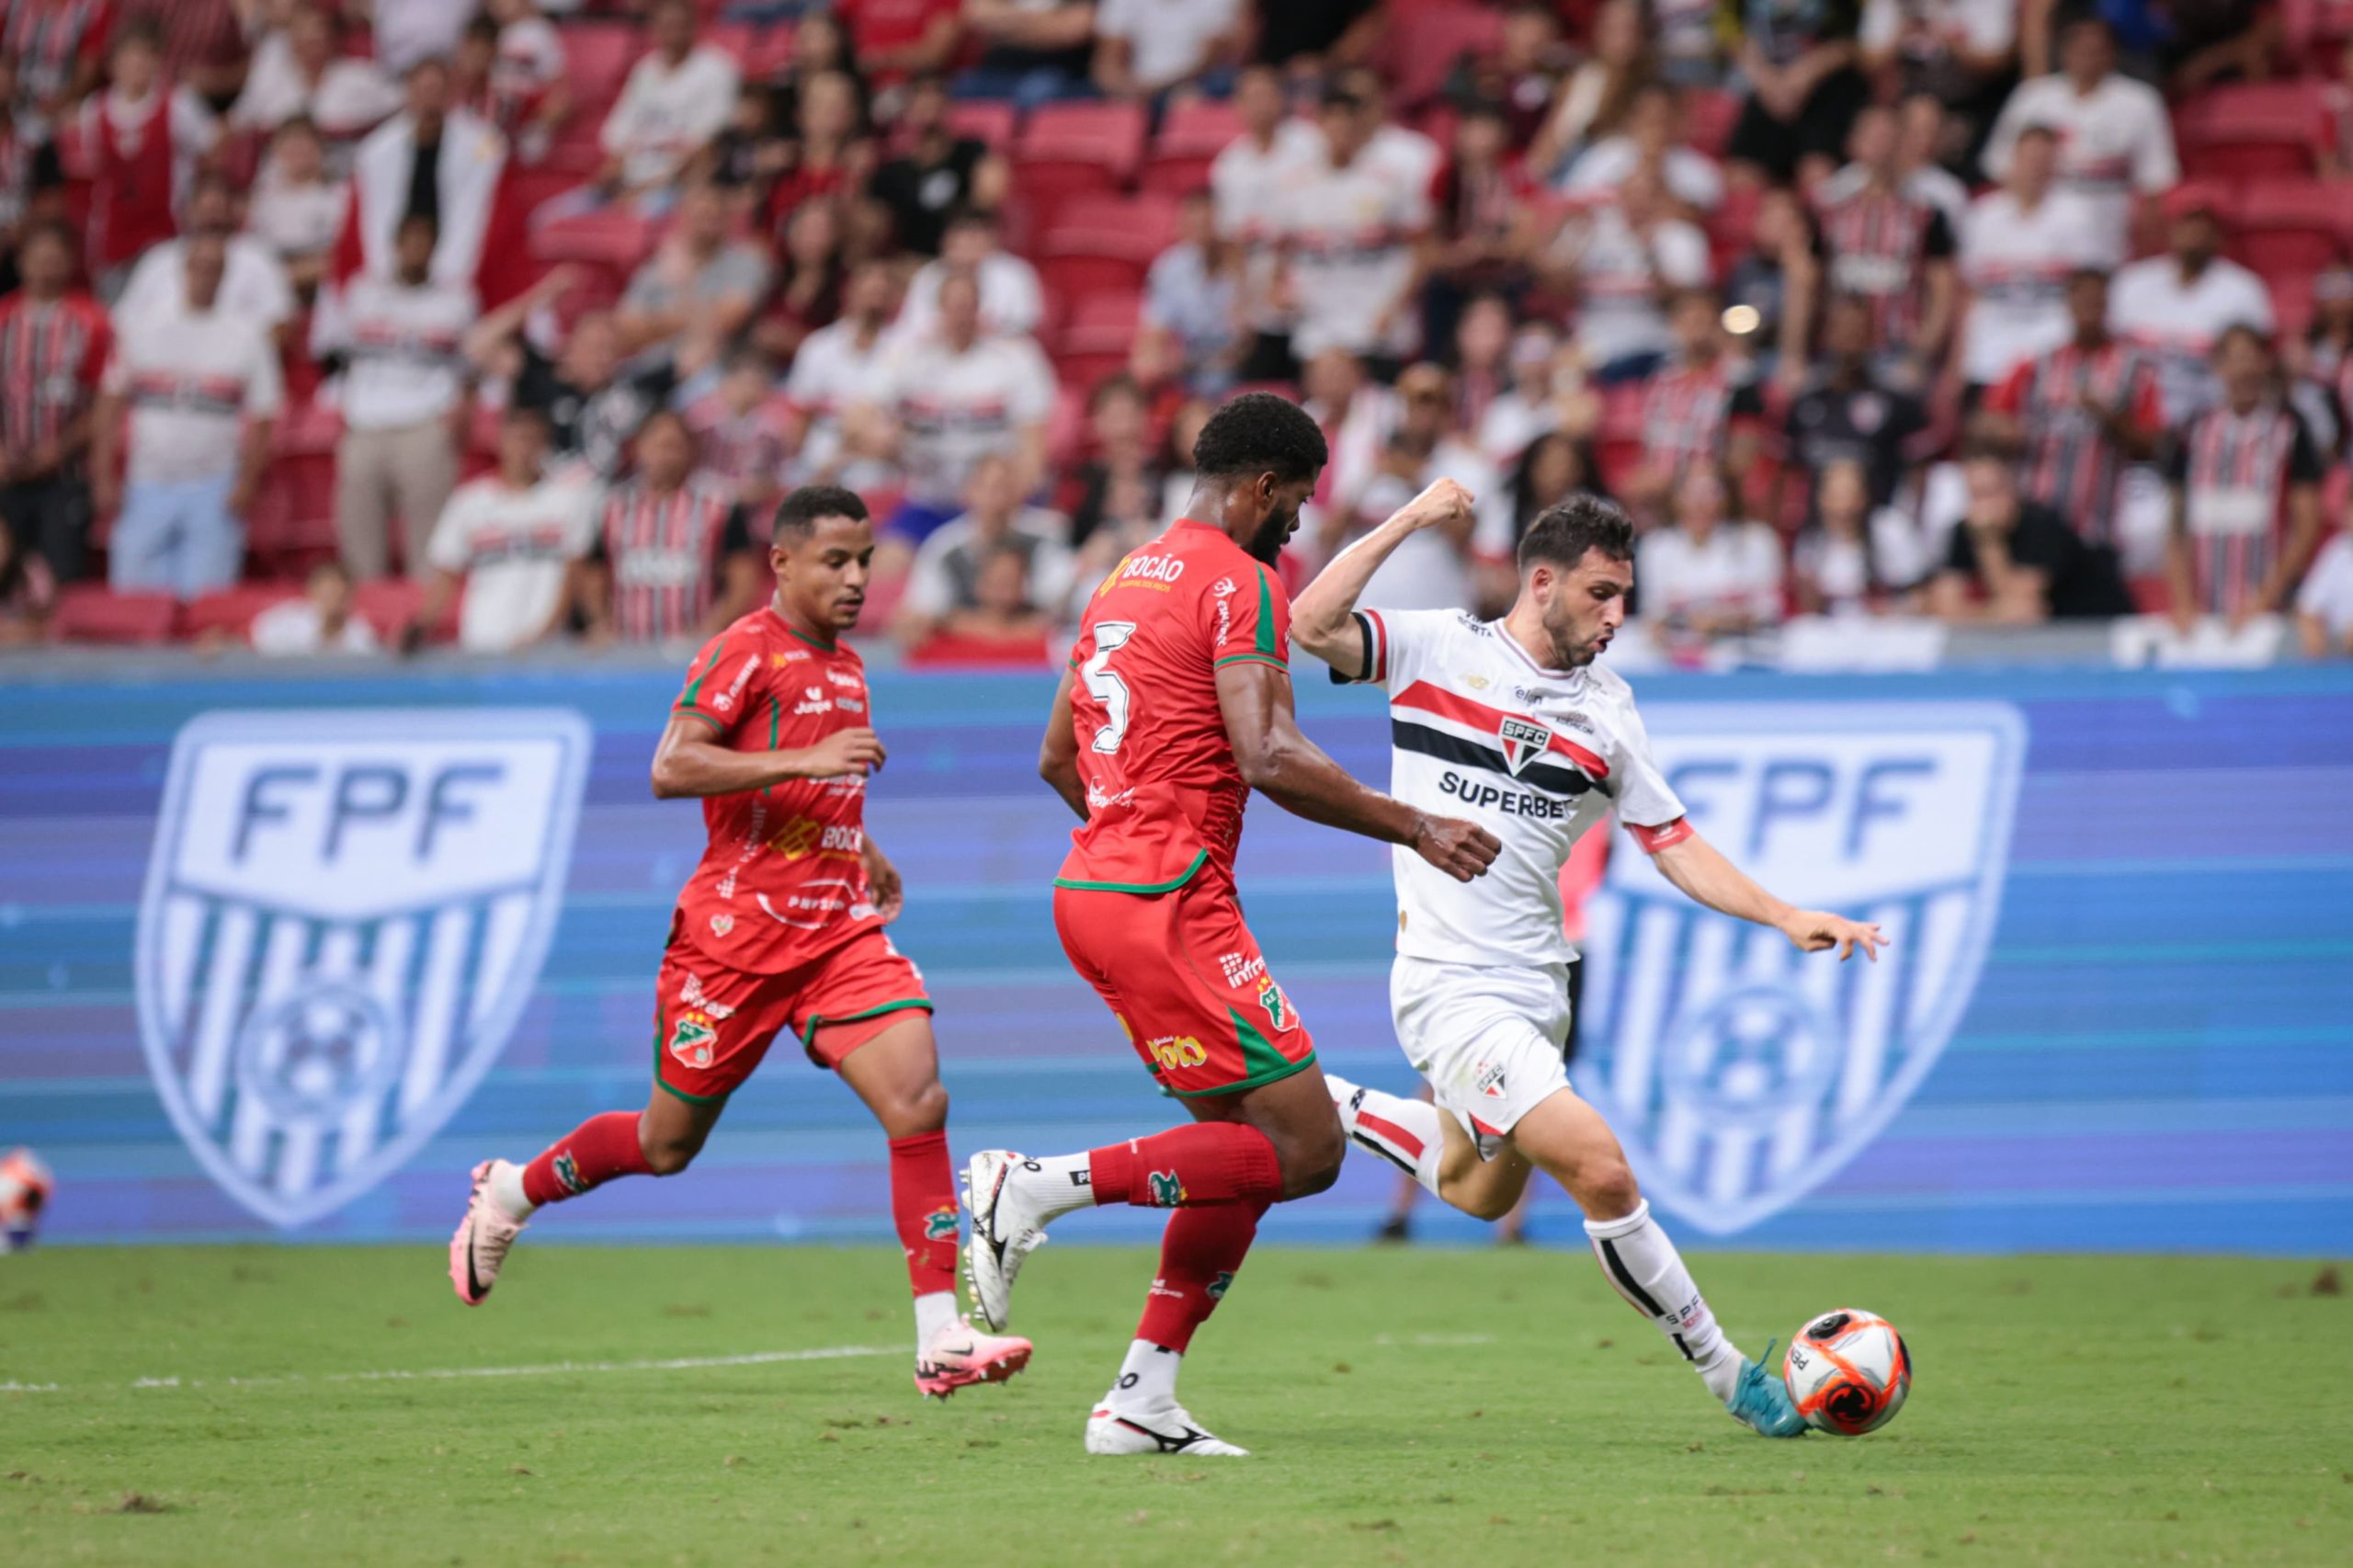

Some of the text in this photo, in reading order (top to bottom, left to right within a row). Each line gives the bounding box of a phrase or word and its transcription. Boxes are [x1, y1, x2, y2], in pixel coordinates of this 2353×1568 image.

[1122, 553, 1184, 582] BOCÃO
[1504, 722, 1546, 744] SPFC
[232, 763, 507, 868] FPF
[1665, 757, 1938, 864] FPF
